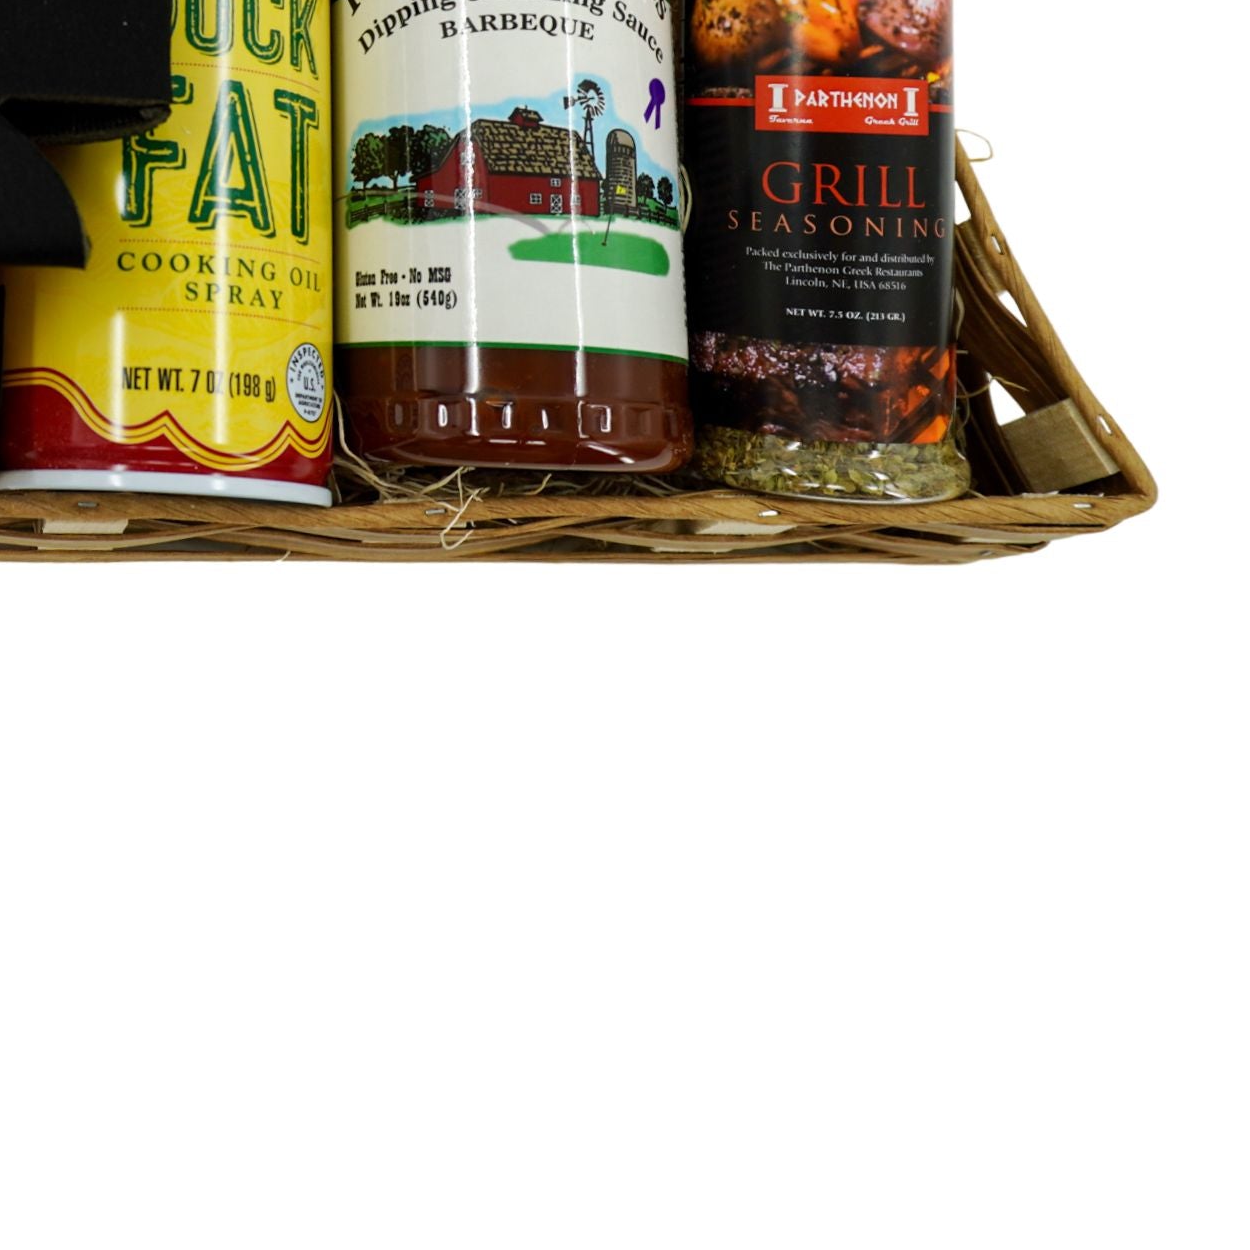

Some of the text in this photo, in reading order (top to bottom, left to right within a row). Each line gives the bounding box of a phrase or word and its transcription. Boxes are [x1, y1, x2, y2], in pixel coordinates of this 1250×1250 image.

[440, 13, 595, 41] BARBEQUE
[612, 0, 664, 64] Sauce
[794, 88, 898, 110] PARTHENON
[120, 74, 320, 247] FAT
[761, 161, 926, 209] GRILL
[727, 210, 946, 238] SEASONING
[746, 246, 780, 258] Packed
[782, 249, 839, 263] exclusively
[841, 250, 856, 262] for
[859, 251, 878, 263] and
[880, 251, 926, 264] distributed
[762, 261, 924, 277] The Parthenon Greek Restaurants
[117, 251, 321, 293] COOKING OIL
[380, 268, 398, 285] Free
[409, 267, 422, 284] No
[428, 266, 452, 283] MSG
[785, 276, 829, 289] Lincoln,
[854, 279, 876, 290] USA
[185, 281, 284, 310] SPRAY
[355, 289, 458, 310] Net Wt. 19oz (540g)
[785, 307, 806, 317] NET
[808, 308, 827, 318] WT.
[828, 309, 843, 319] 7.5
[845, 310, 864, 320] OZ.
[121, 367, 152, 391] NET
[157, 367, 185, 393] WT.
[191, 369, 200, 392] 7
[228, 372, 263, 399] (198
[265, 377, 277, 403] g)
